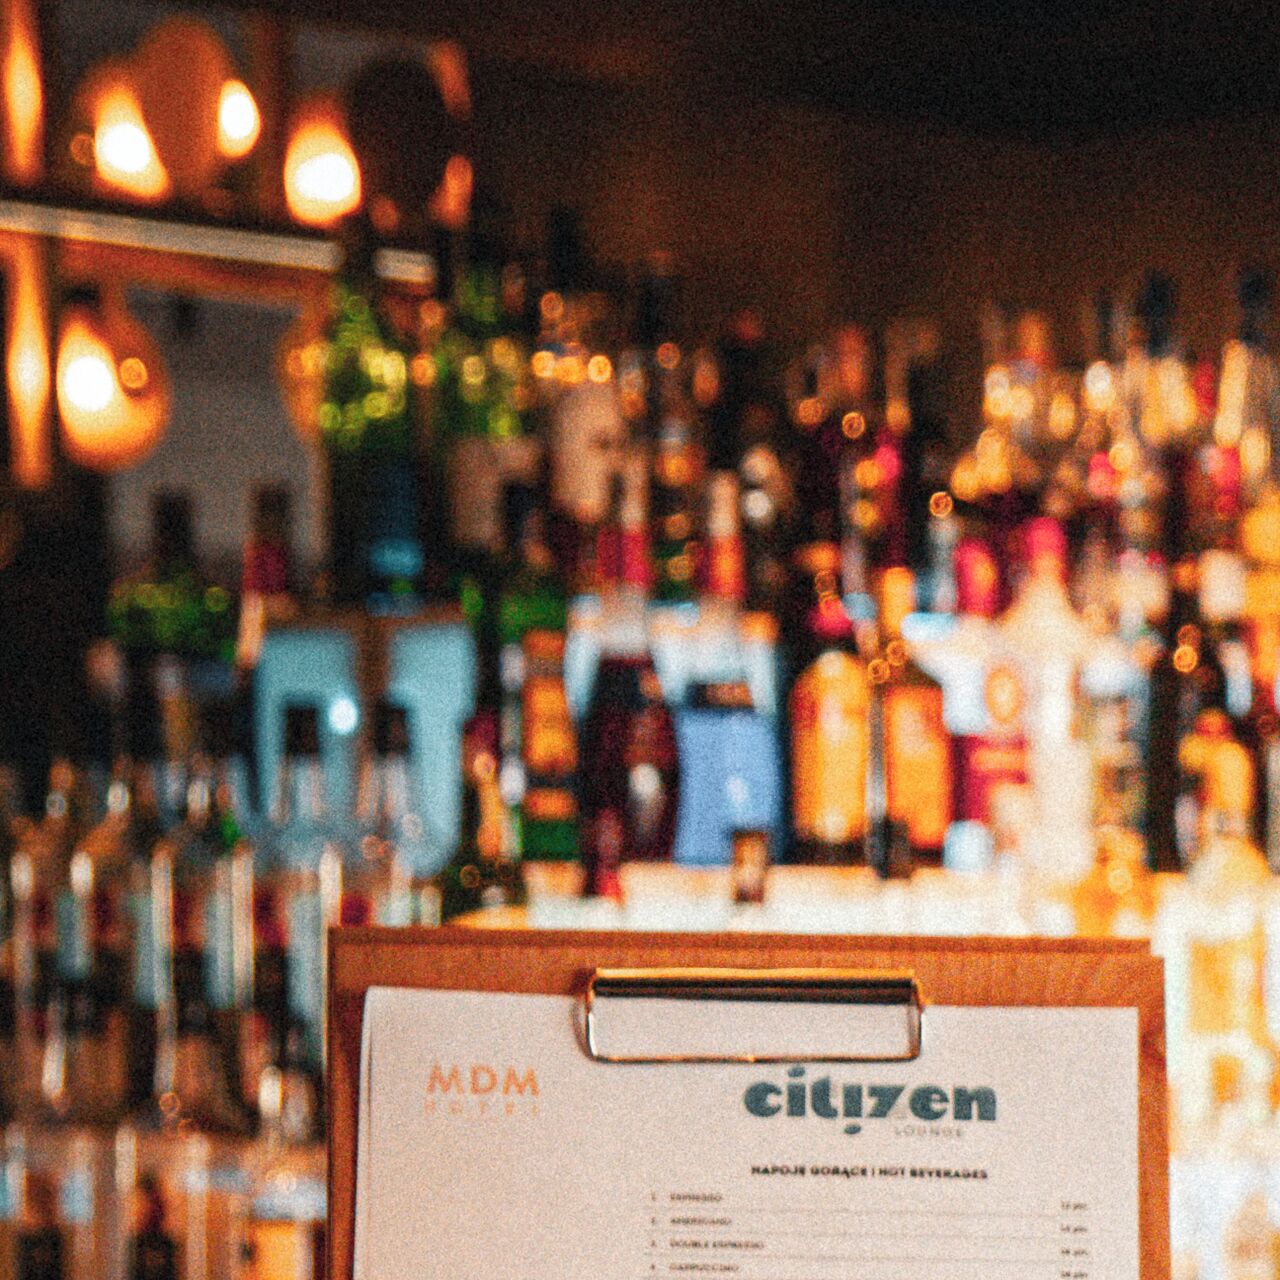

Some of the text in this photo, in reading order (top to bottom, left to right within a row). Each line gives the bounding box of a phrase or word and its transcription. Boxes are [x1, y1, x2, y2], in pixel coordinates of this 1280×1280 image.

[427, 1063, 539, 1096] MDM
[743, 1066, 996, 1135] citizen
[751, 1165, 806, 1177] NAPOJE
[878, 1167, 906, 1178] HOT
[909, 1168, 988, 1180] BEVERAGES
